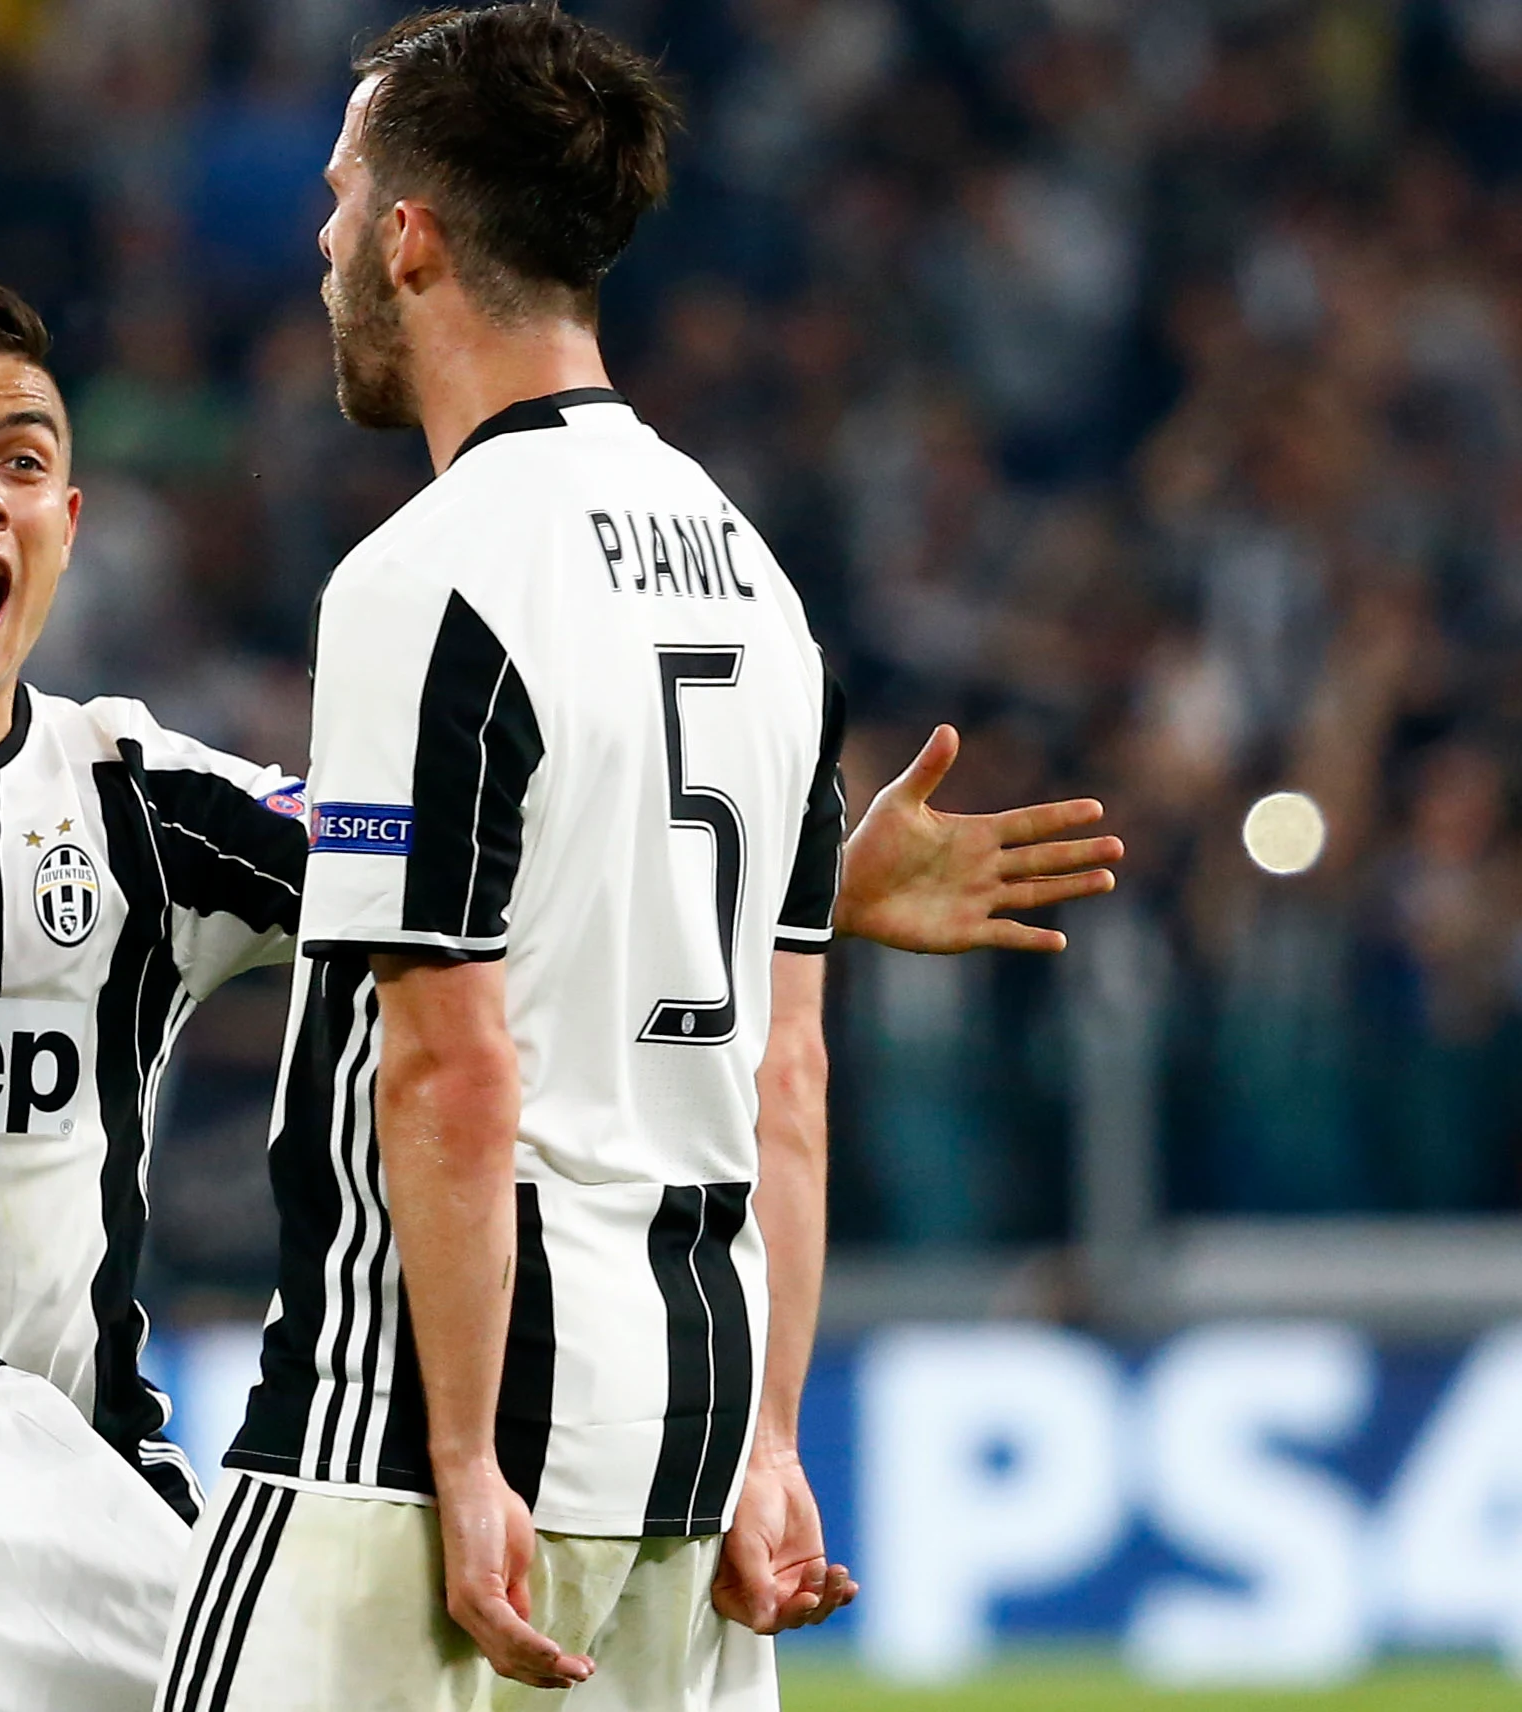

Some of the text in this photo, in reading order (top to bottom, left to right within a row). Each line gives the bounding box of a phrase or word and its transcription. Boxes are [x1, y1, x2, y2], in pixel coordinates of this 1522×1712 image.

[585, 500, 757, 601] PJANIĆ
[40, 867, 93, 885] JUVENTUS
[634, 644, 748, 1046] 5
